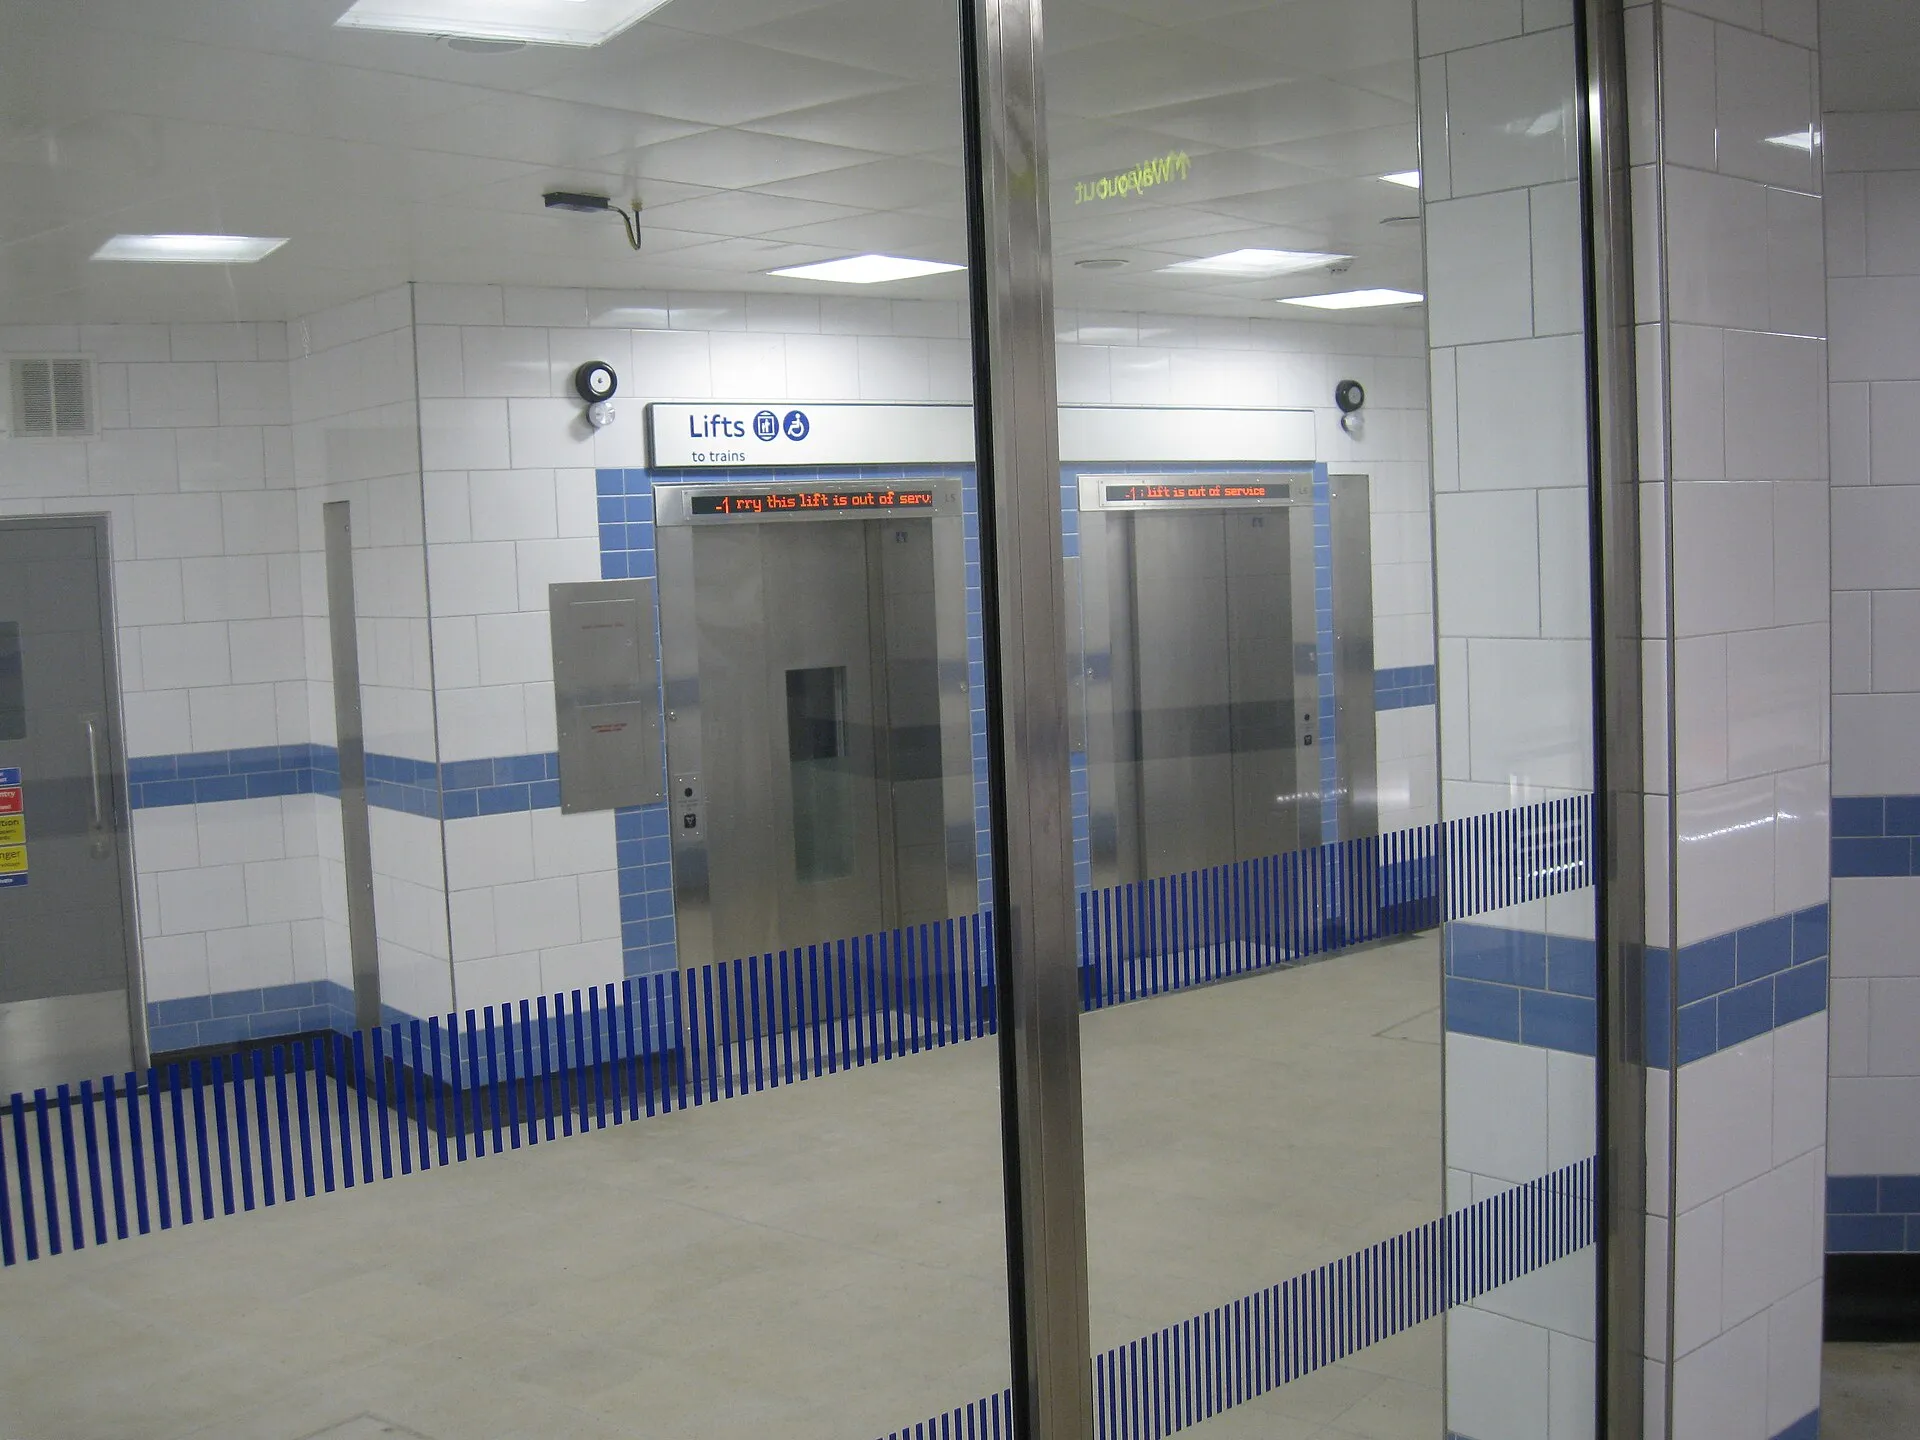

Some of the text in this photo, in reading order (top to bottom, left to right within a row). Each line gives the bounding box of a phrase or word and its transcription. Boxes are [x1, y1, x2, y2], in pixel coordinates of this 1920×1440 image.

[689, 414, 745, 438] Lifts
[692, 450, 746, 462] to trains
[1147, 485, 1170, 498] lift
[1173, 486, 1185, 497] is
[1188, 487, 1206, 497] out
[1209, 484, 1221, 496] of
[1224, 486, 1266, 497] service
[736, 499, 762, 513] rry
[766, 494, 796, 509] this
[799, 492, 829, 507] lift
[832, 495, 848, 506] is
[851, 493, 875, 506] out
[879, 490, 895, 505] of
